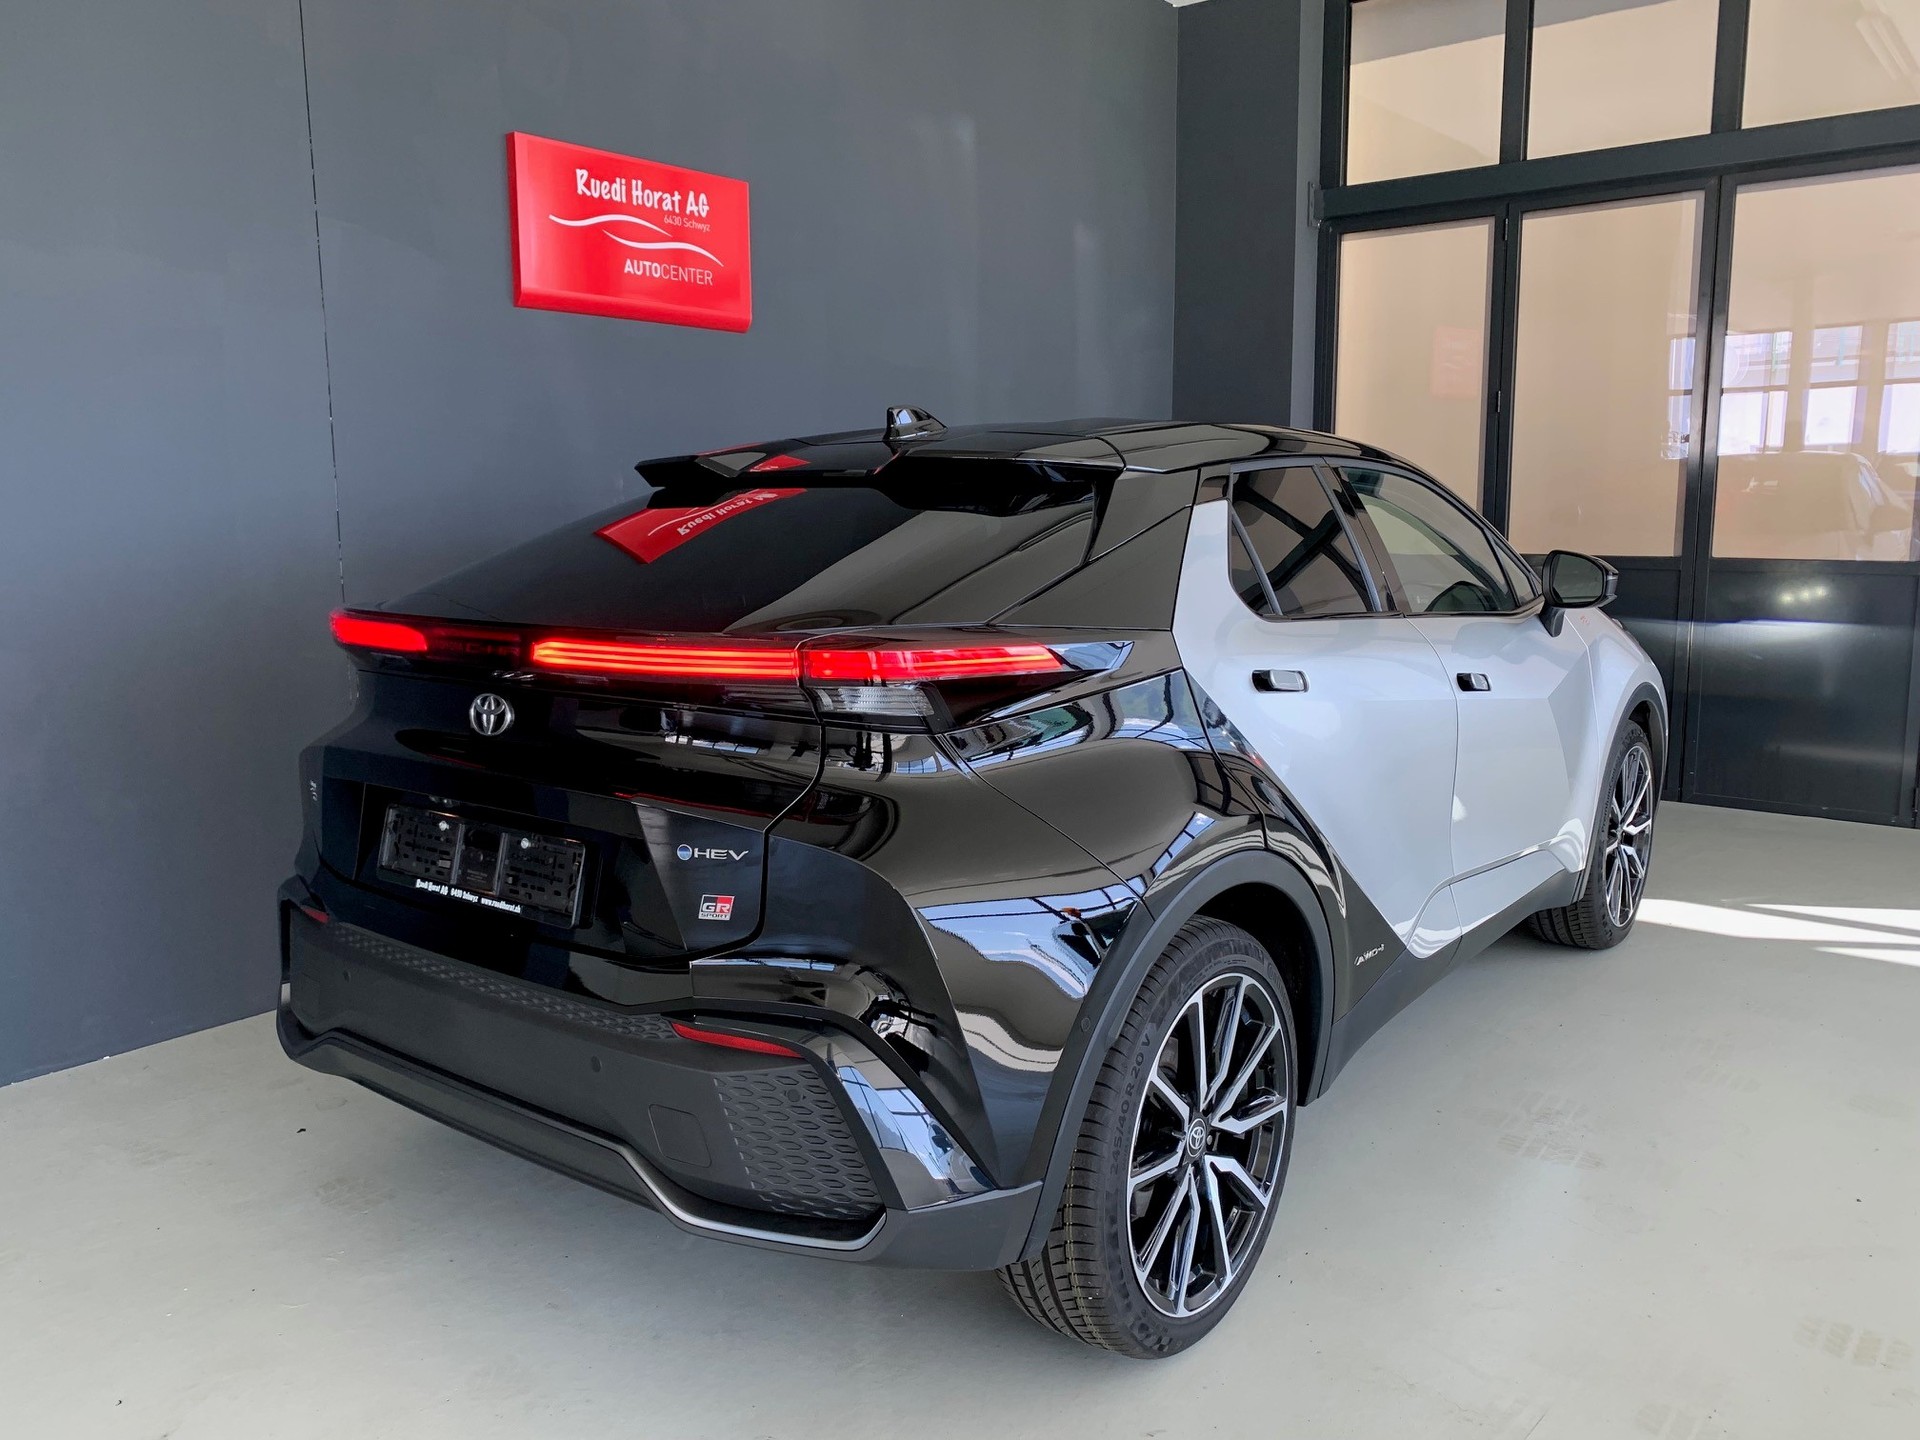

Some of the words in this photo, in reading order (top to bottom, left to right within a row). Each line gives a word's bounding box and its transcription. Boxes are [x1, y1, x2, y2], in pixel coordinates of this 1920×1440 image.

[575, 168, 627, 204] Ruedi
[631, 179, 682, 214] Horat
[686, 191, 710, 218] AG
[663, 214, 682, 227] 6430
[683, 217, 711, 233] Schwyz
[623, 258, 714, 286] AUTOCENTER
[693, 847, 749, 861] HEV
[702, 902, 730, 913] GR
